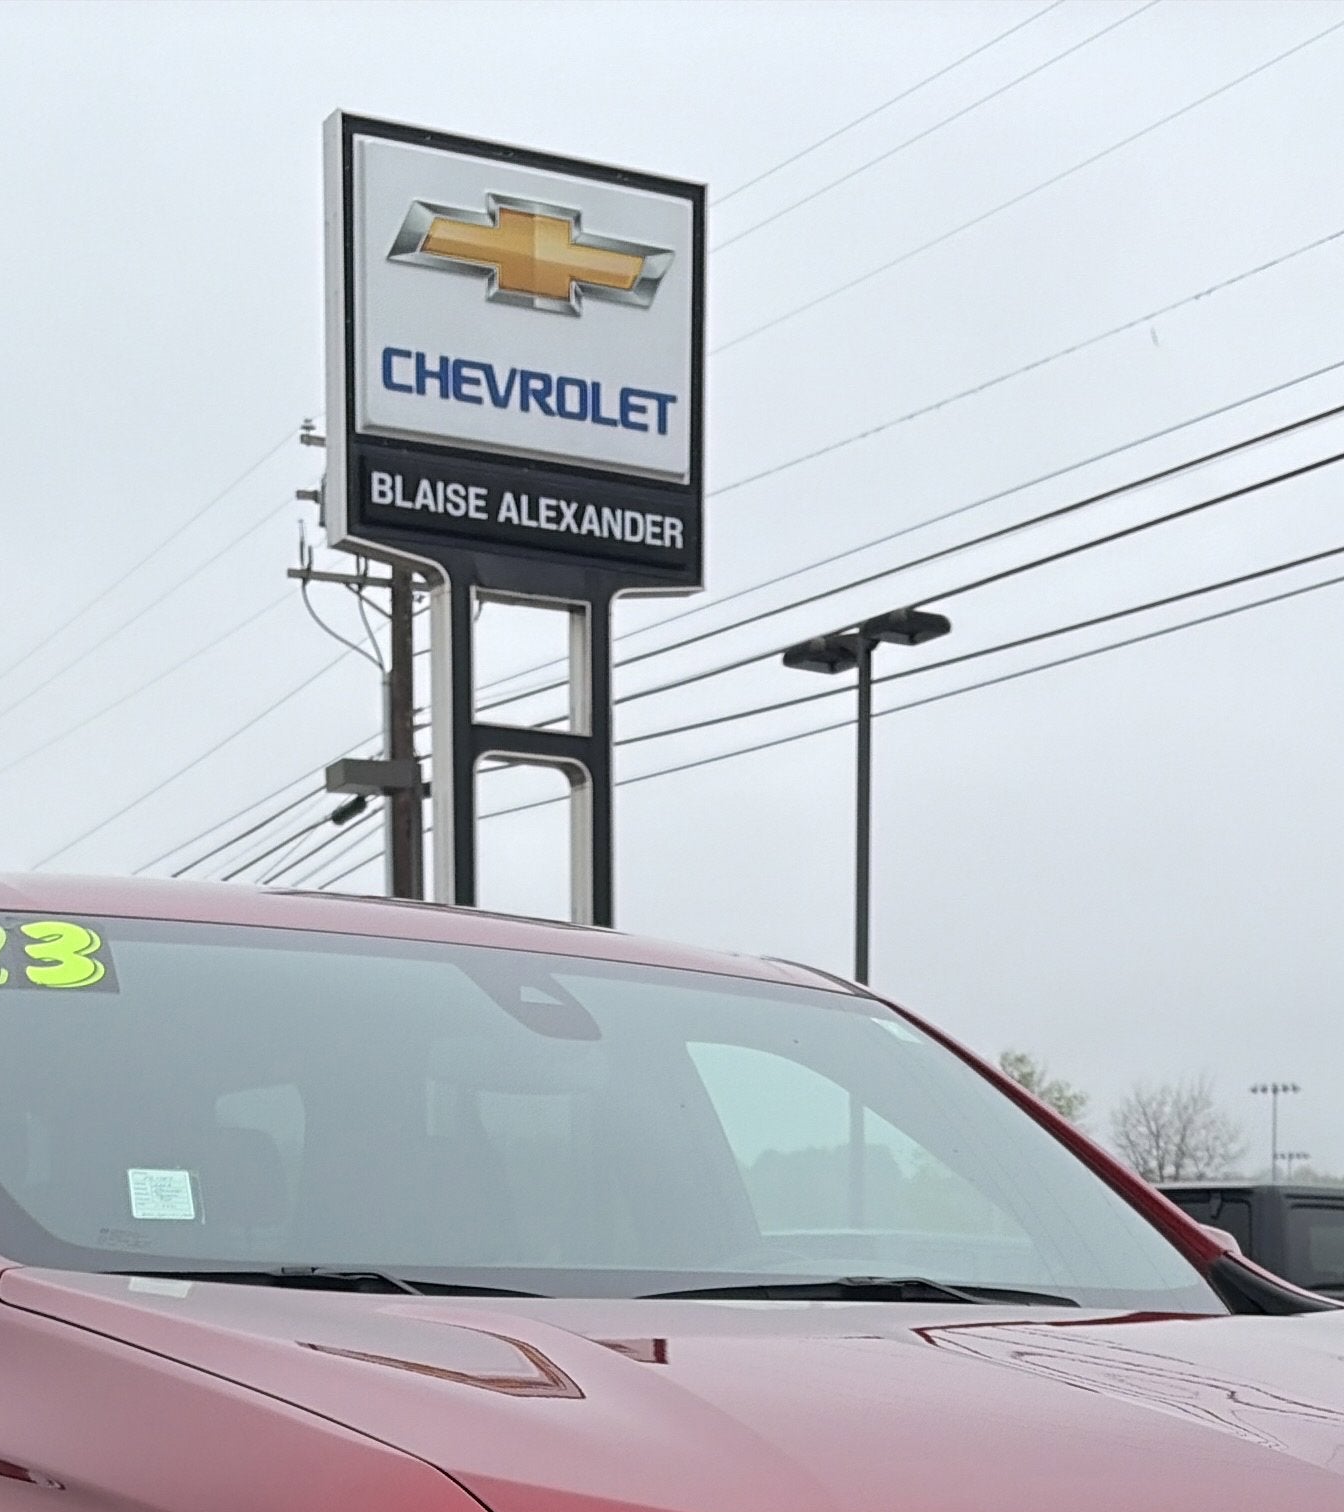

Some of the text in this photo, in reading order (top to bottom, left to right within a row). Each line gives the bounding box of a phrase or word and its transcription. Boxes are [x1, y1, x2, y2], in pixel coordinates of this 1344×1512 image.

[381, 346, 678, 436] CHEVROLET
[370, 471, 684, 549] BLAISE ALEXANDER
